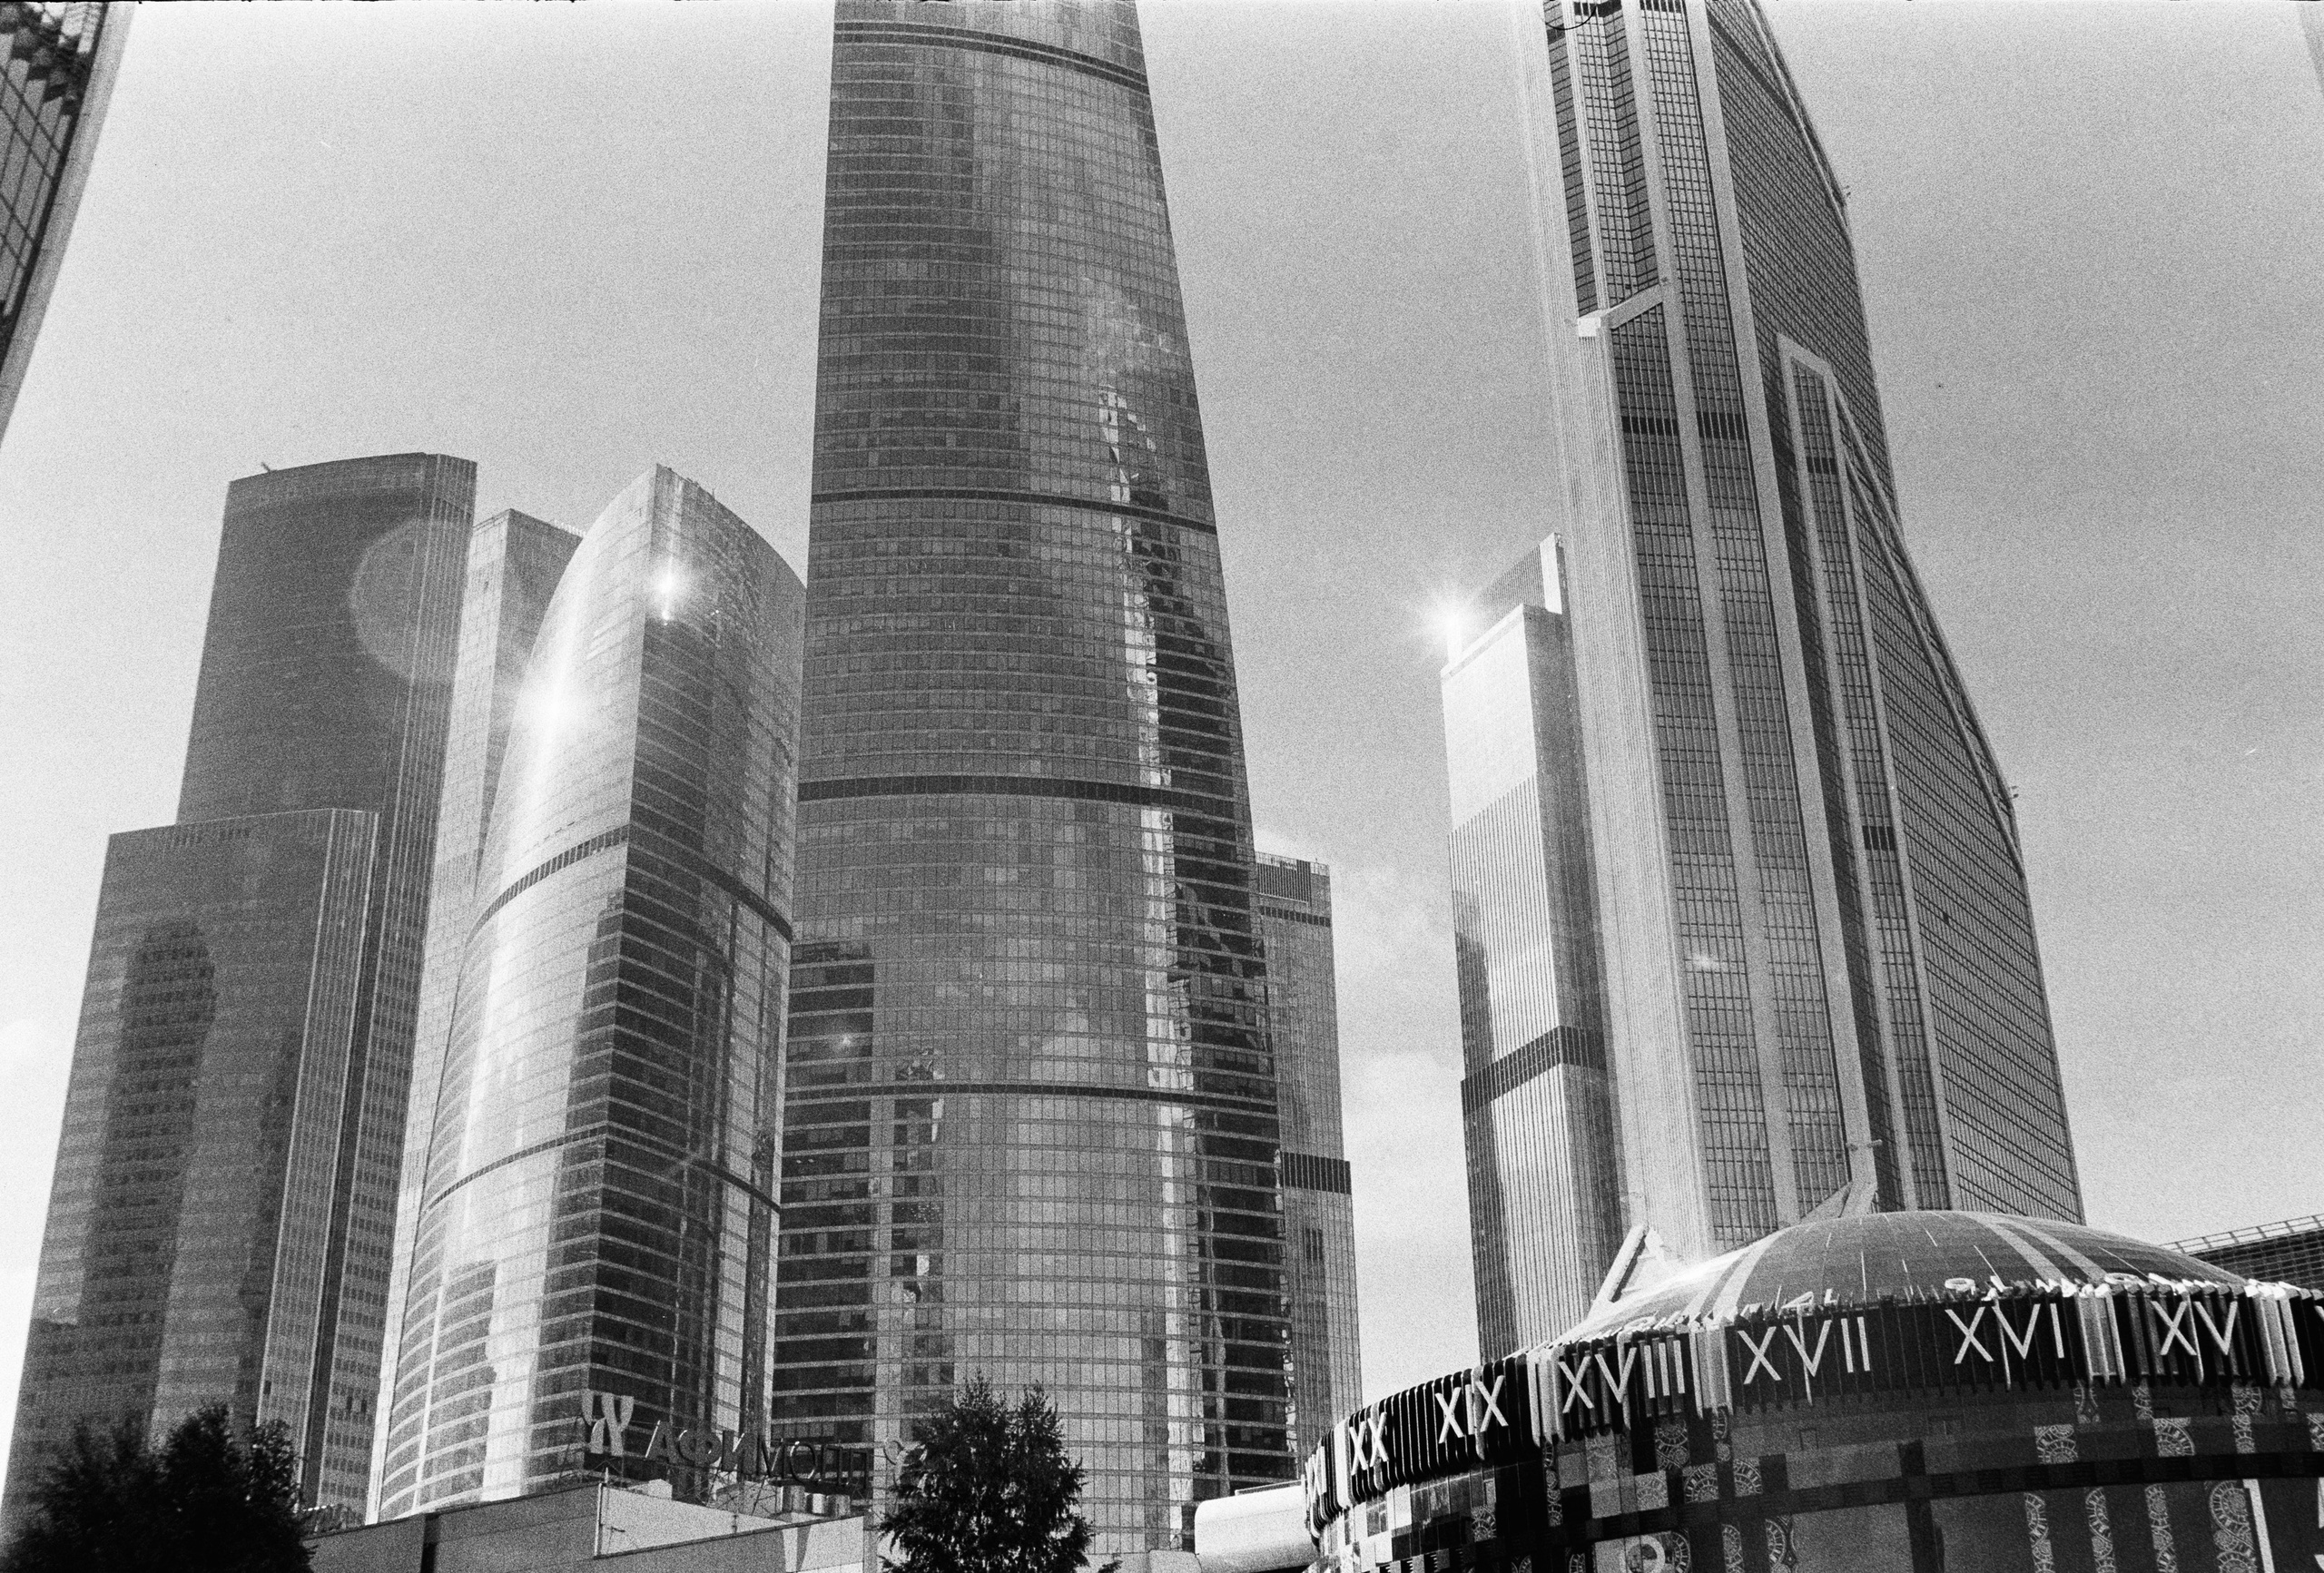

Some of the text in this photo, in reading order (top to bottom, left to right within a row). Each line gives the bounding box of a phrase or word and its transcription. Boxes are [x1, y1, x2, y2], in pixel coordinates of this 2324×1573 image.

[1349, 1411, 1389, 1477] XX
[1434, 1374, 1509, 1445] XIX
[1559, 1339, 1686, 1414] XVIII
[1738, 1316, 1871, 1386] XVII
[1944, 1303, 2064, 1365] XVI
[2151, 1301, 2239, 1356] XV
